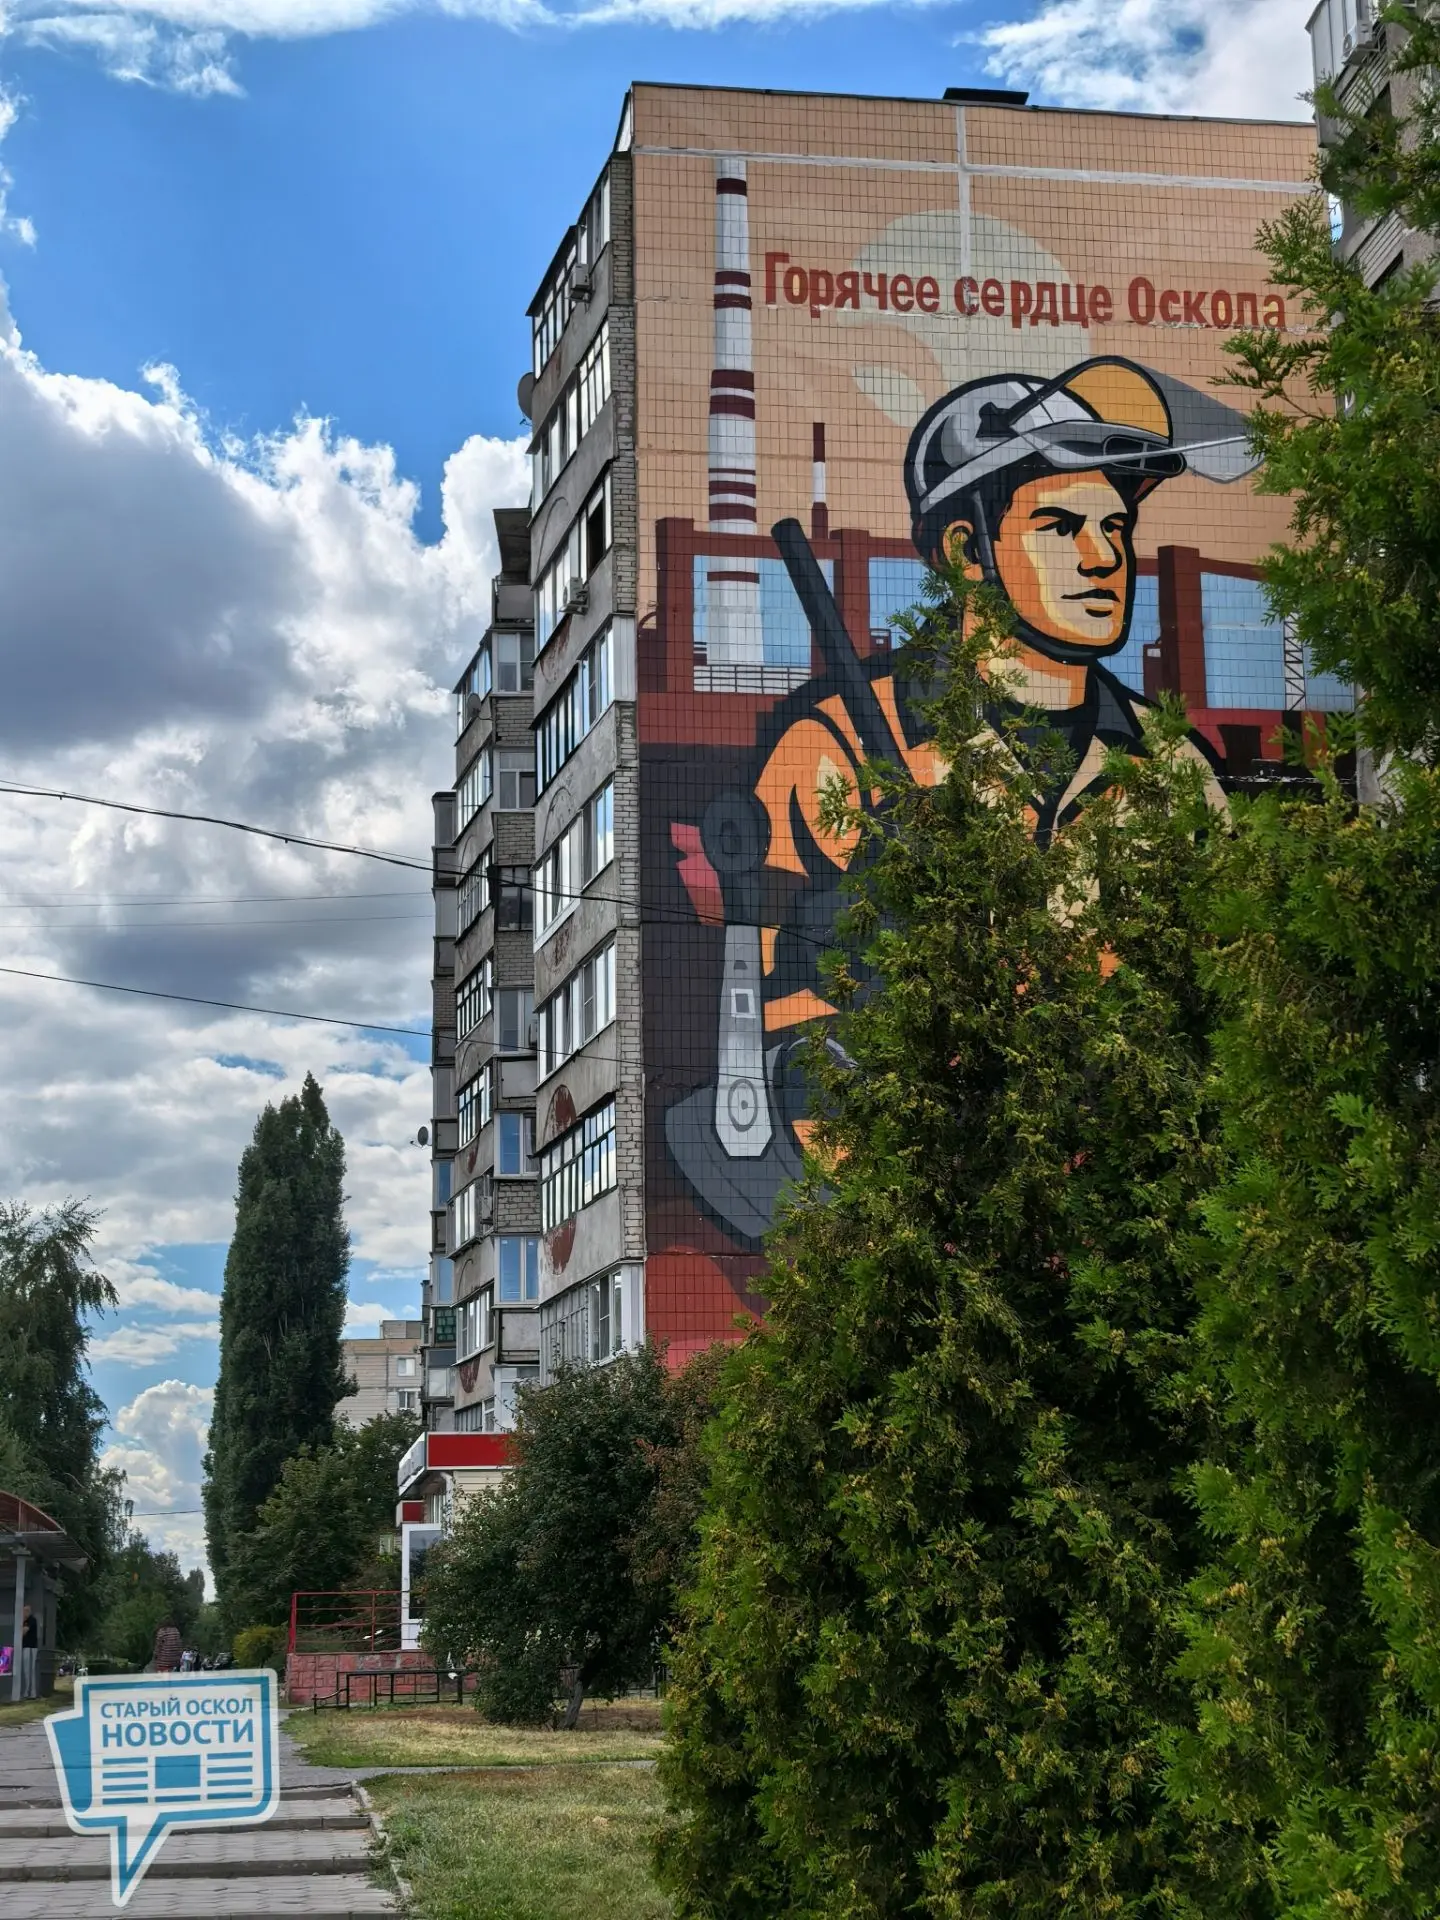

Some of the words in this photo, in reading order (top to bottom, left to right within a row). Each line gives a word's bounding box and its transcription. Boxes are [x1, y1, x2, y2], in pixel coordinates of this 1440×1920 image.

[765, 251, 940, 318] Горячее
[954, 276, 1113, 329] сердце
[1128, 276, 1286, 330] Оскола
